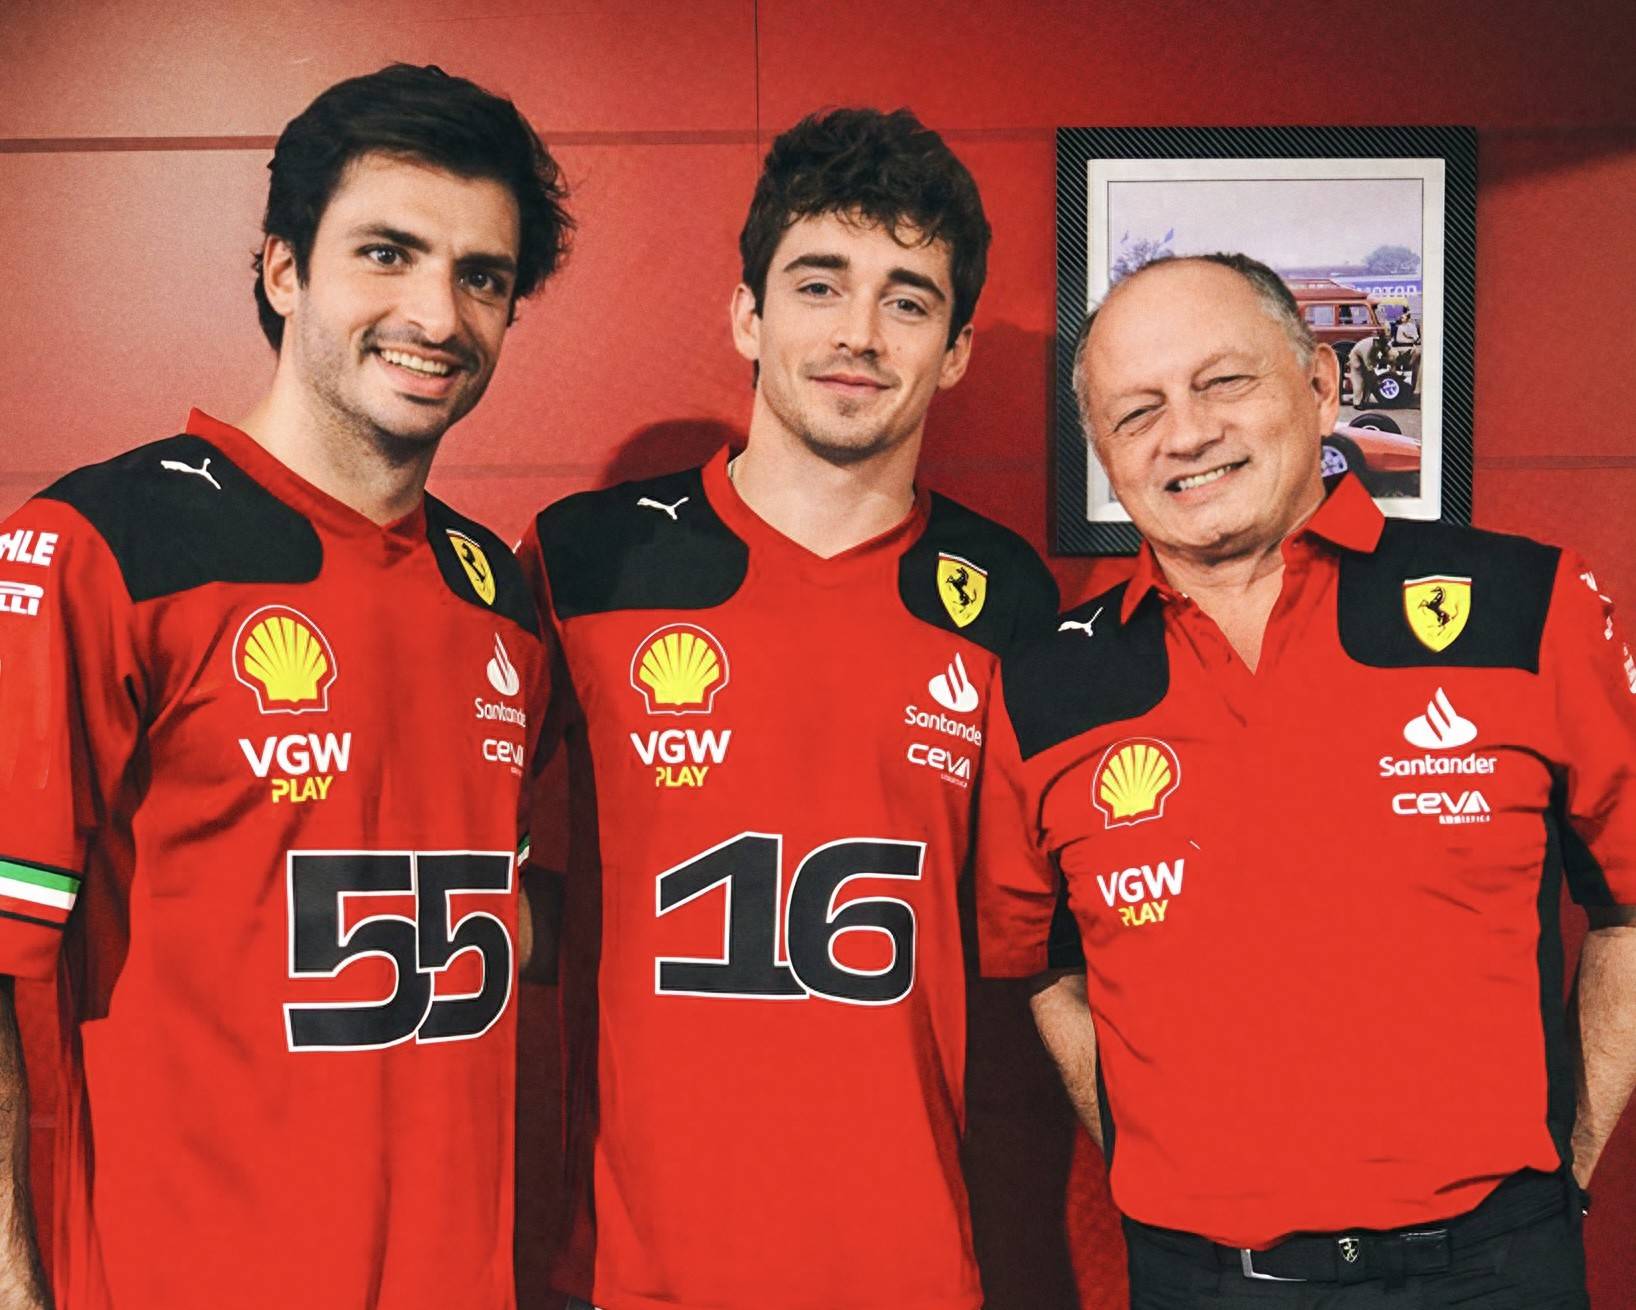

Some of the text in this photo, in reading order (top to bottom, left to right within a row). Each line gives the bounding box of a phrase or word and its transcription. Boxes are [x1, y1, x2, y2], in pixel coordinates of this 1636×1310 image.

[238, 732, 352, 777] VGW
[630, 729, 732, 765] VGW
[1379, 753, 1498, 777] Santander
[271, 776, 334, 804] PLAY
[655, 765, 709, 787] PLAY
[1096, 858, 1185, 907] VGW
[655, 832, 927, 1006] 16
[1118, 899, 1169, 927] PLAY
[283, 849, 515, 1053] 55
